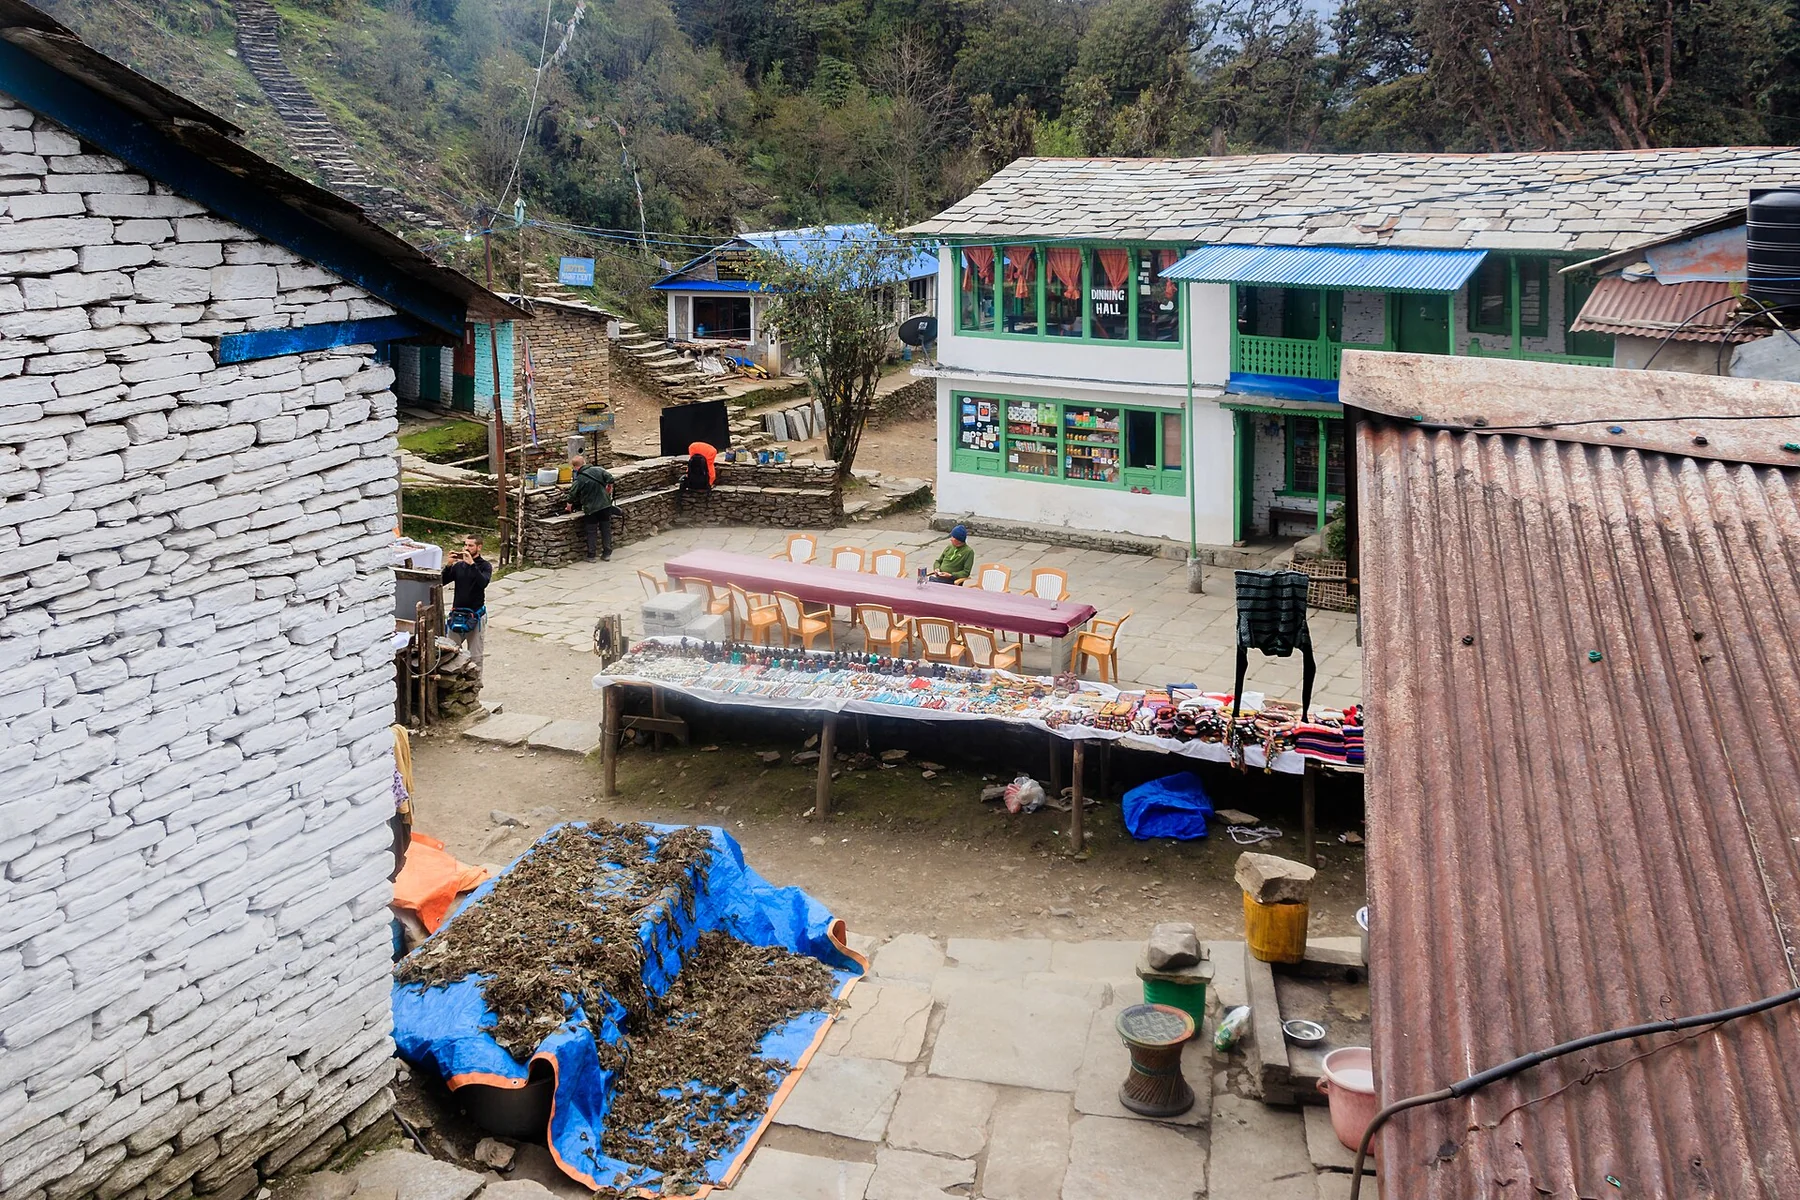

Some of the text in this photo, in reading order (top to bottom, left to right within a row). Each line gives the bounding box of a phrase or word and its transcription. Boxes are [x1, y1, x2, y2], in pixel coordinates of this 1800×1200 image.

[564, 264, 586, 272] HOTEL
[1091, 289, 1125, 300] DINNING
[1096, 302, 1120, 314] HALL
[1420, 307, 1426, 317] 2
